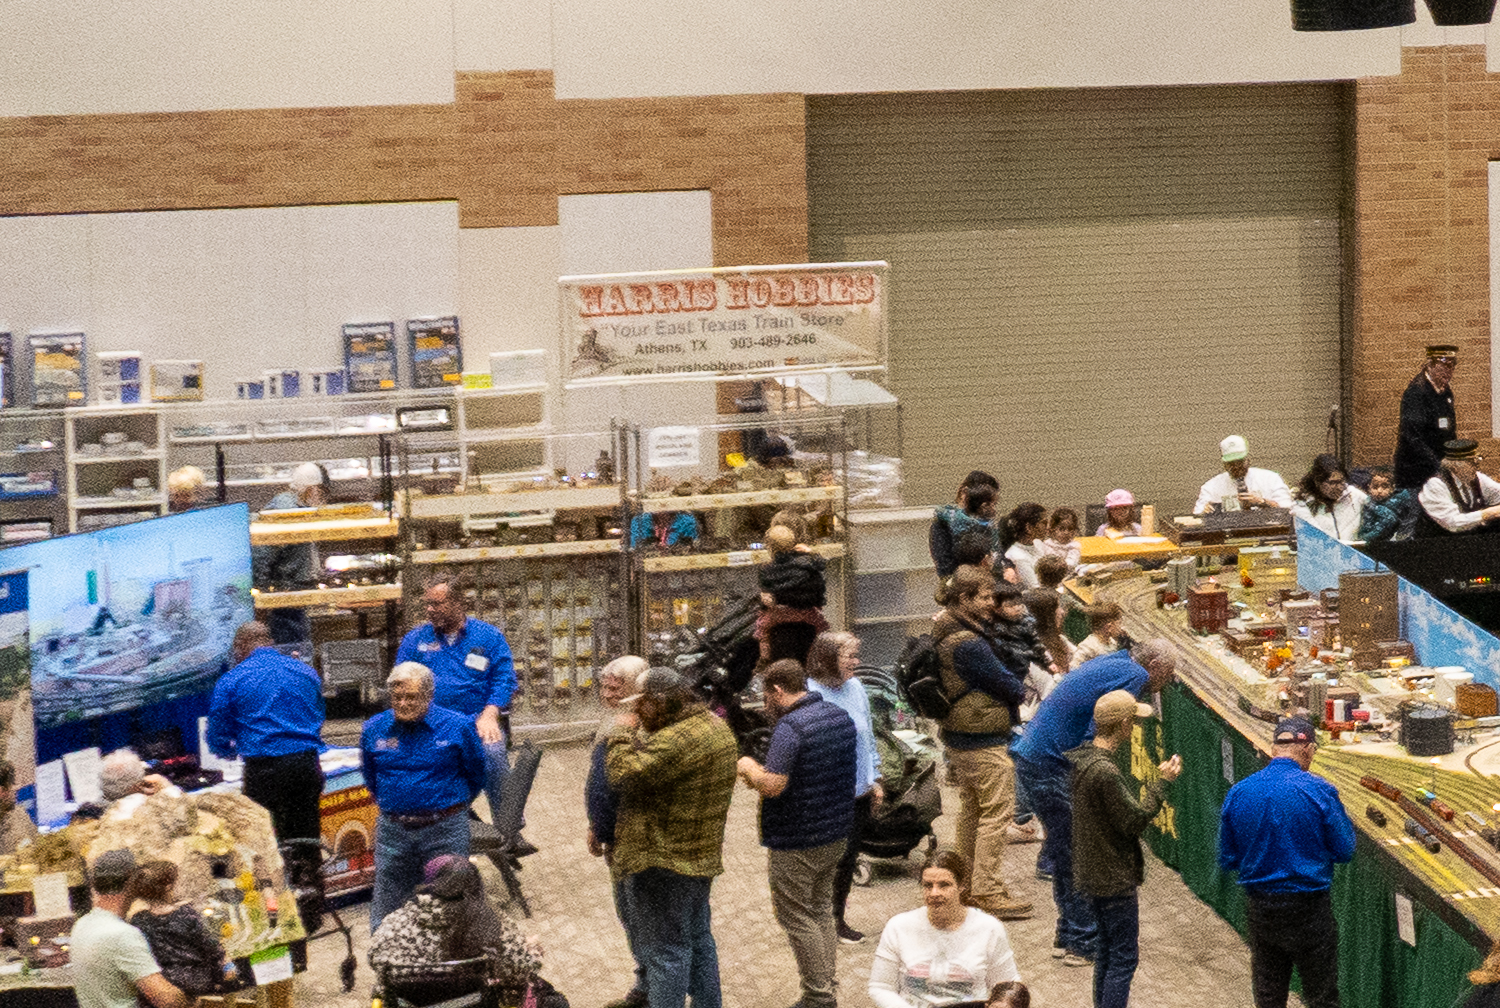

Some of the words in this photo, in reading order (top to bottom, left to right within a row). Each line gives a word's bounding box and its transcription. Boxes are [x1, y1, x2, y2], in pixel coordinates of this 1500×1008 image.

[578, 278, 717, 318] HARRIS
[725, 272, 877, 310] HOBBIES
[655, 319, 694, 336] East
[699, 316, 747, 332] Texas
[754, 313, 794, 329] Train
[634, 341, 686, 357] Athens,
[689, 338, 708, 352] TX
